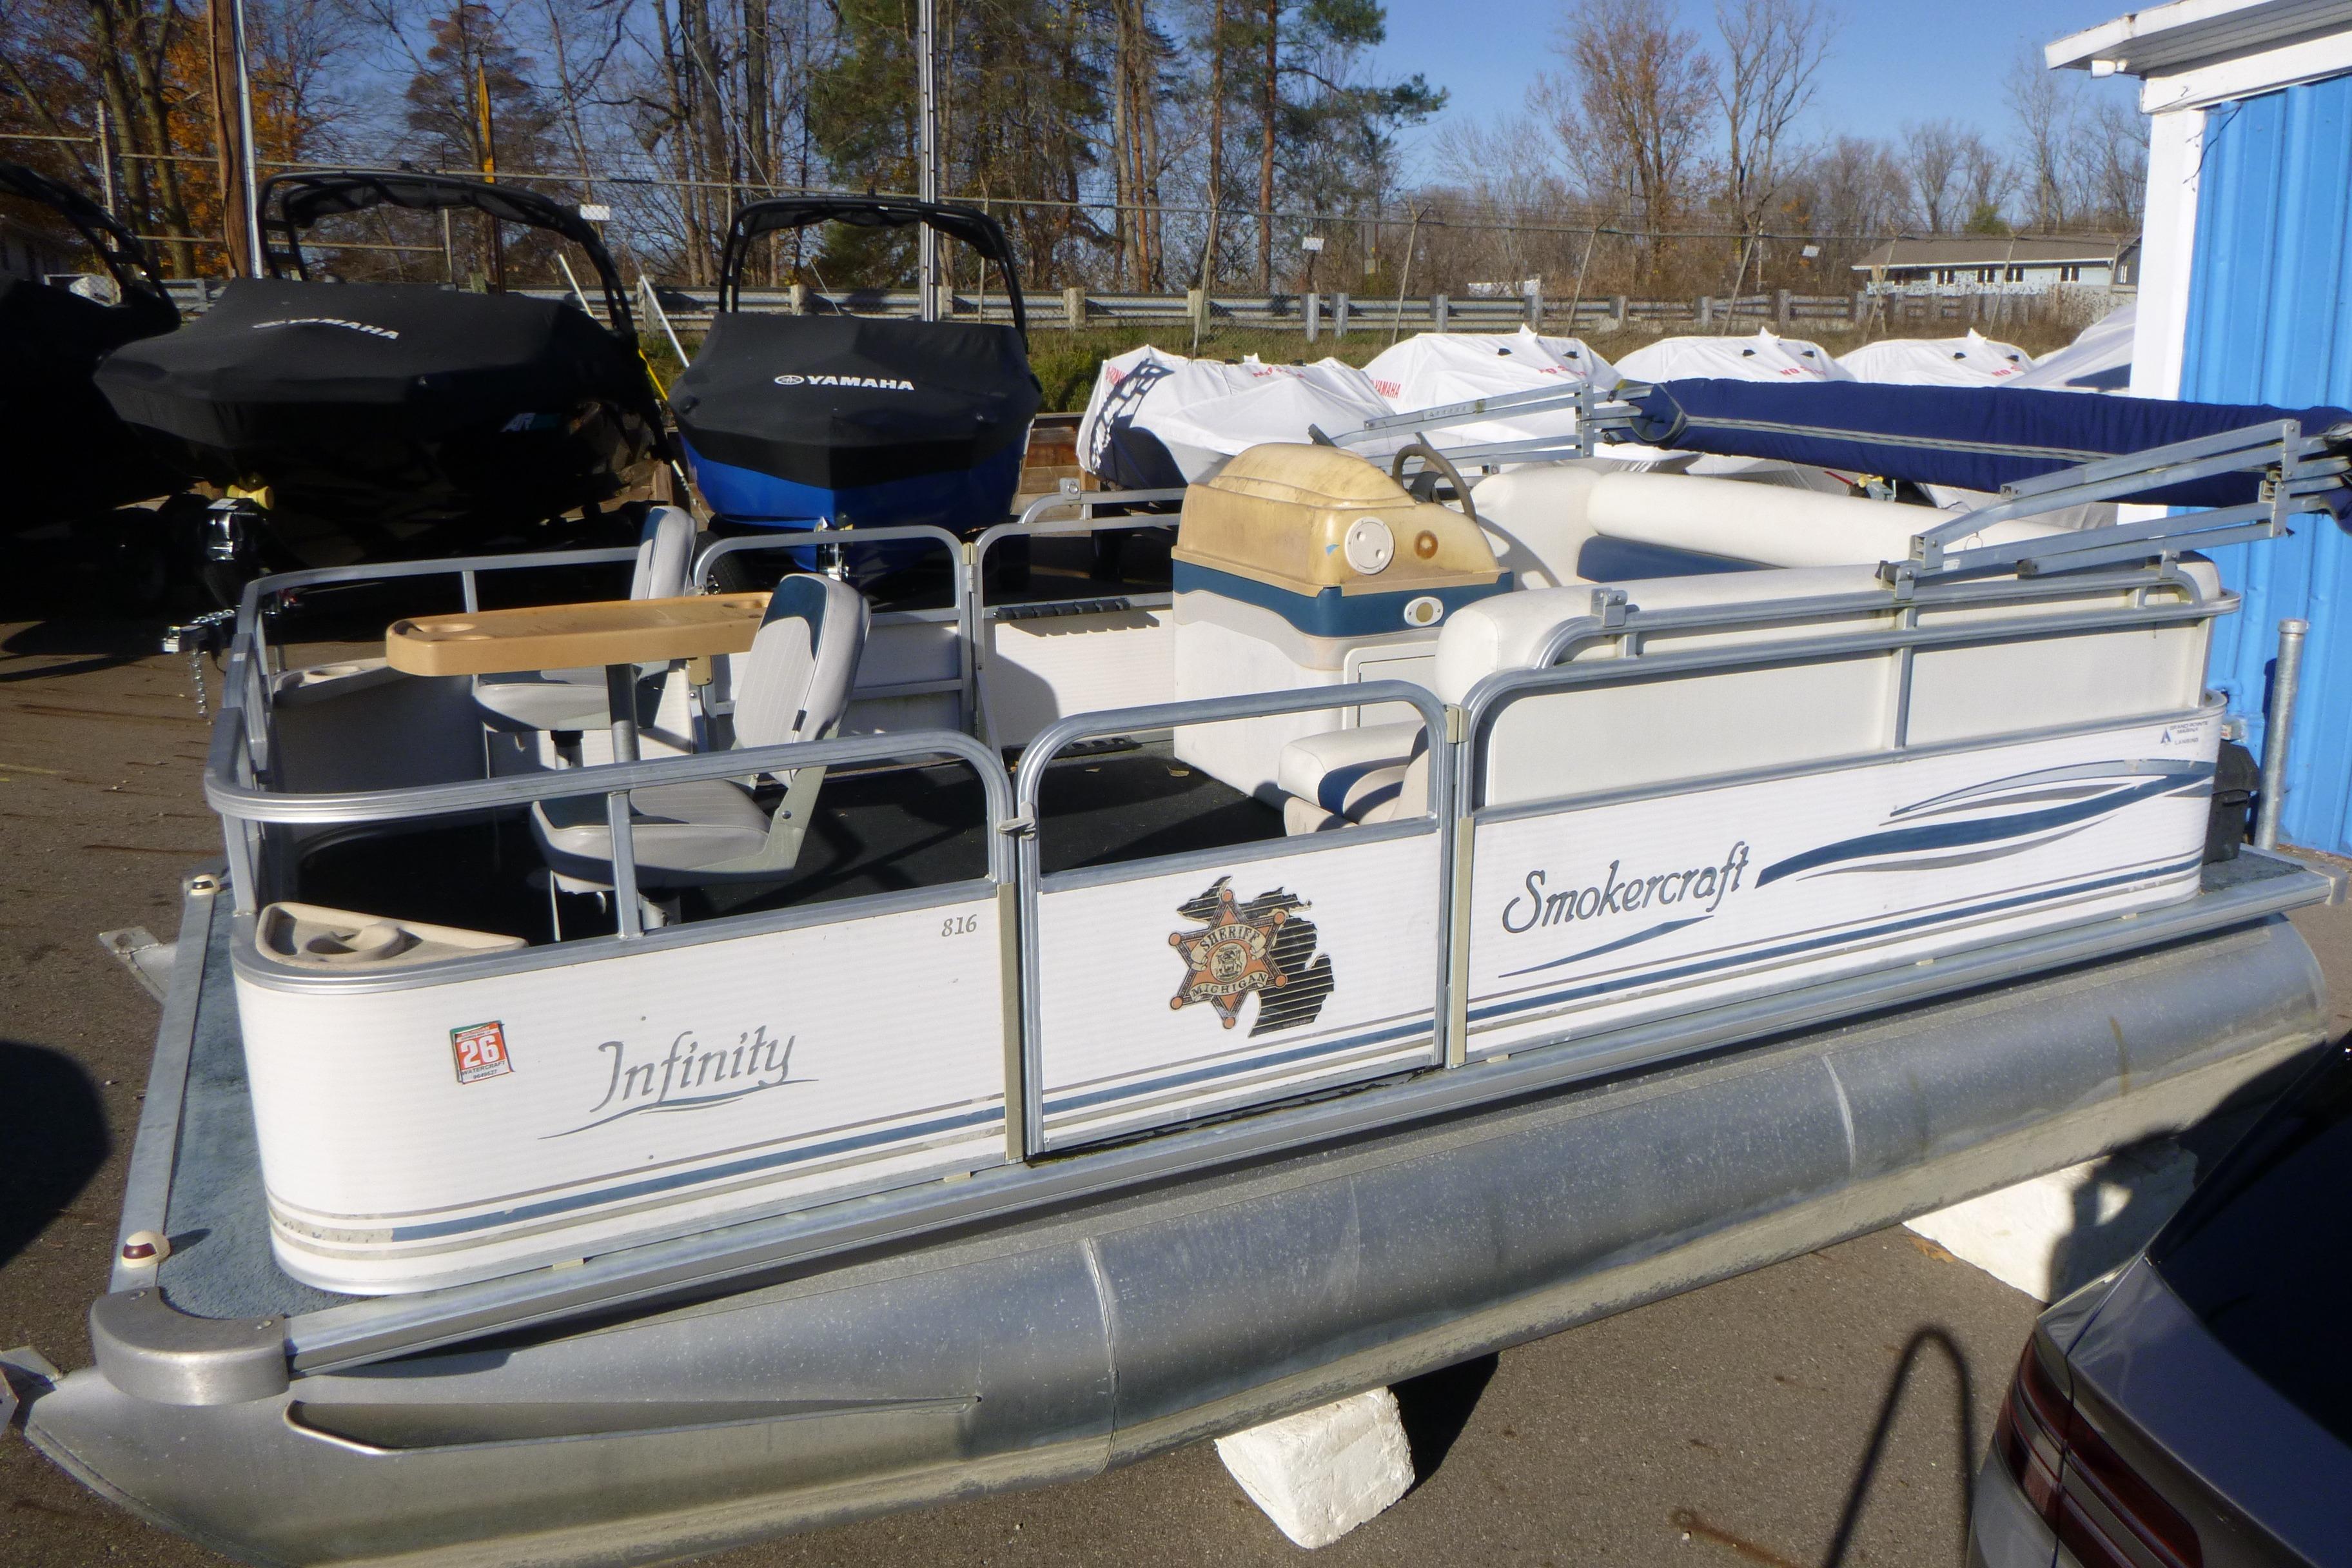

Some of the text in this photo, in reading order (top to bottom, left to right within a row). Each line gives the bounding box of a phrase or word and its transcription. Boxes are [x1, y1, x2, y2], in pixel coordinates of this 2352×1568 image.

[807, 375, 915, 391] YAMAHA
[1502, 840, 1749, 934] Smokercraft
[941, 914, 977, 937] 816
[1199, 925, 1260, 952] SHERIFF
[1191, 972, 1268, 997] MICHIGAN
[460, 1035, 500, 1068] 26
[460, 1060, 506, 1076] WATERCRAFT
[589, 1024, 796, 1113] Infinity
